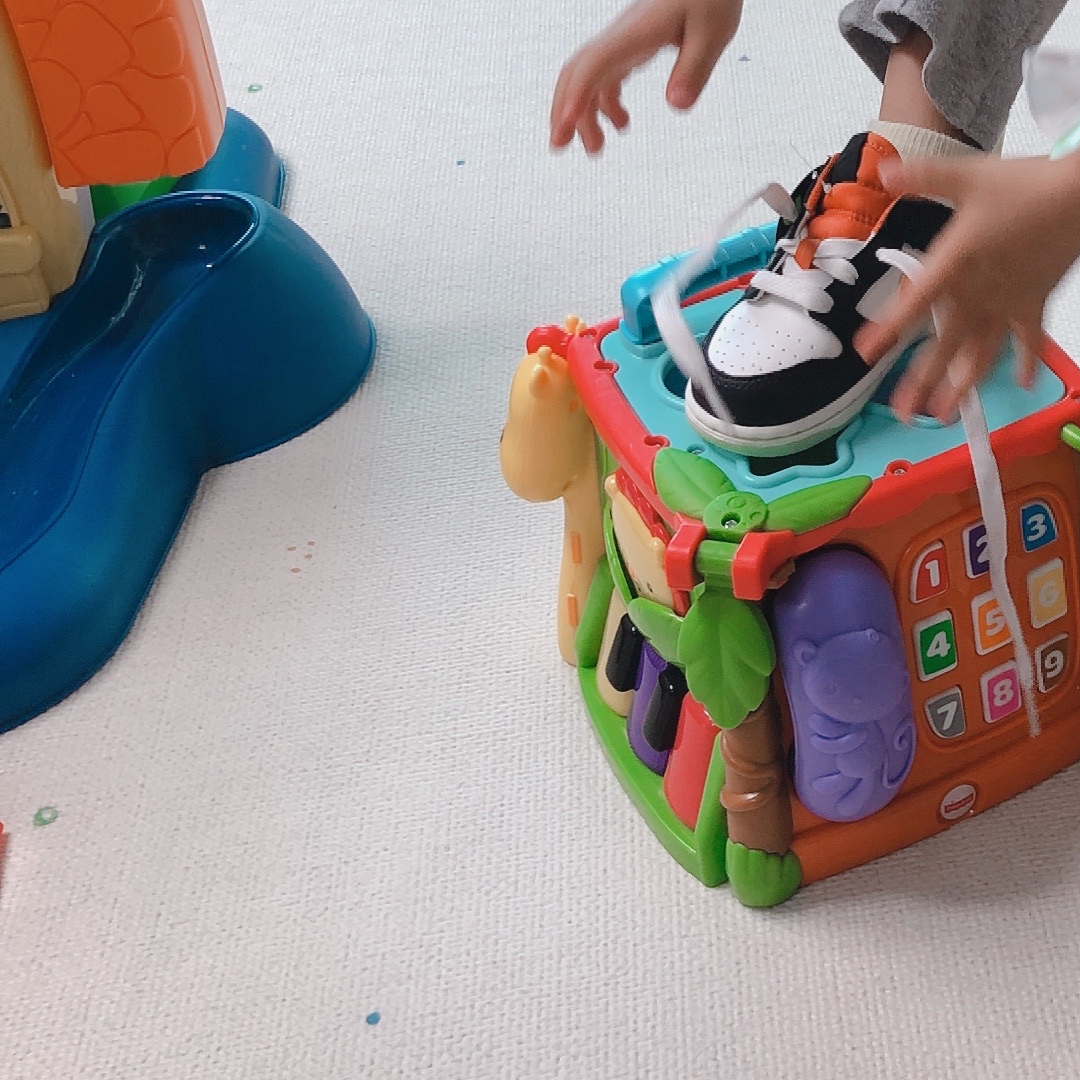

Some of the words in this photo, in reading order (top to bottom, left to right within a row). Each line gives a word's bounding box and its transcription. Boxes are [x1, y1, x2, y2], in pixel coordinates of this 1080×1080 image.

[925, 559, 941, 588] 1
[976, 534, 990, 564] 2
[1026, 513, 1048, 542] 3
[926, 631, 951, 658] 4
[985, 606, 1006, 637] 5
[1038, 580, 1060, 608] 6
[936, 701, 958, 731] 7
[992, 678, 1015, 707] 8
[1044, 649, 1064, 679] 9
